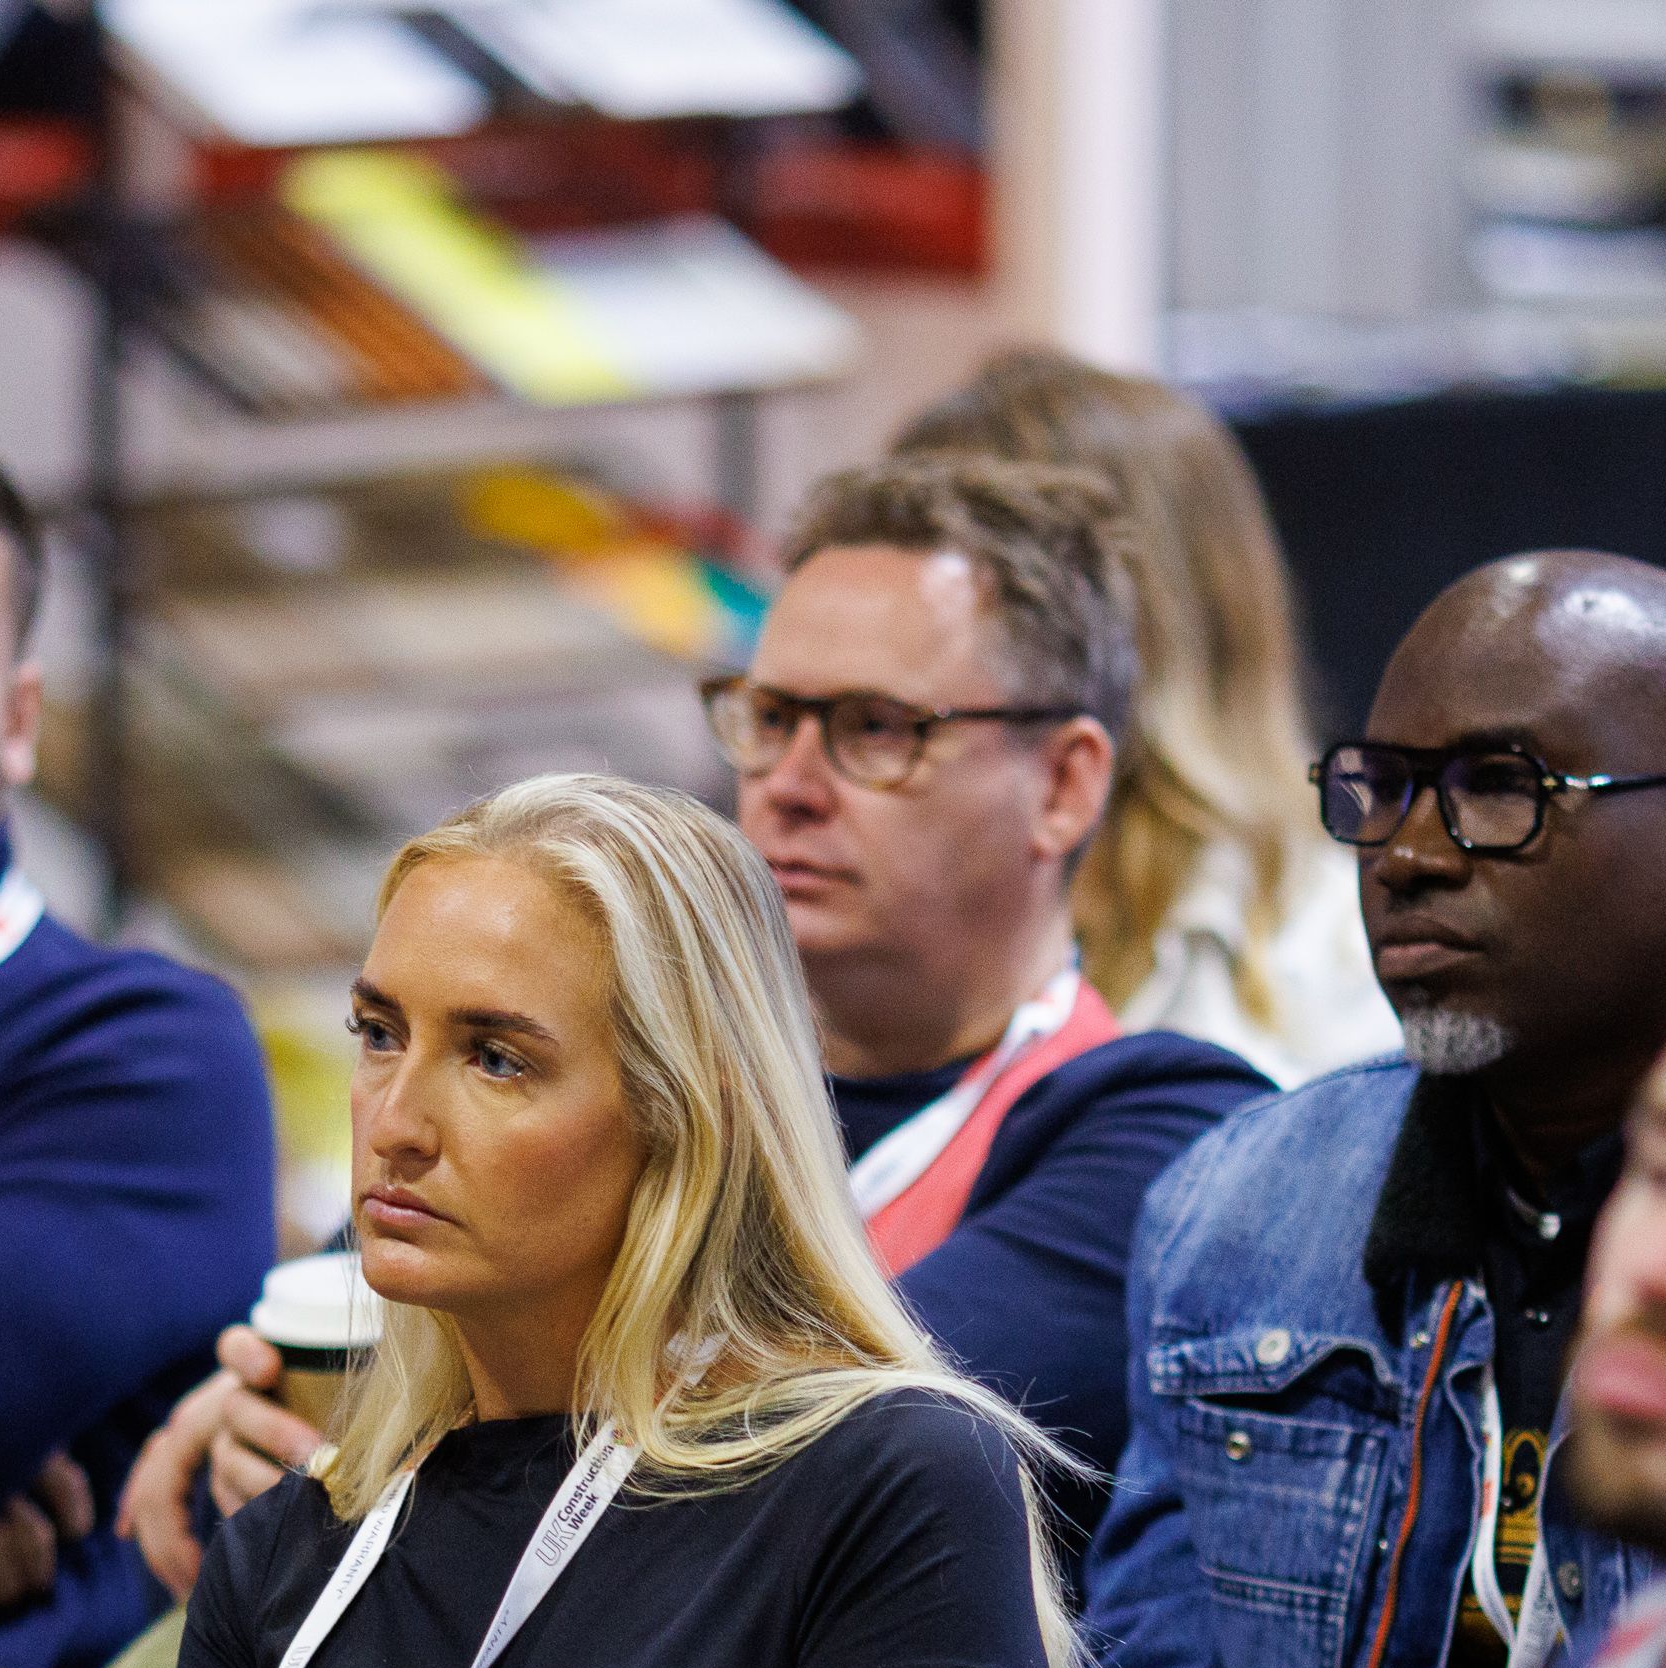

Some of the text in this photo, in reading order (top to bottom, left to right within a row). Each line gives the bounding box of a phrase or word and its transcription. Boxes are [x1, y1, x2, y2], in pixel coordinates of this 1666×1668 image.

[535, 1445, 615, 1567] UK Construction
[568, 1493, 600, 1531] Week
